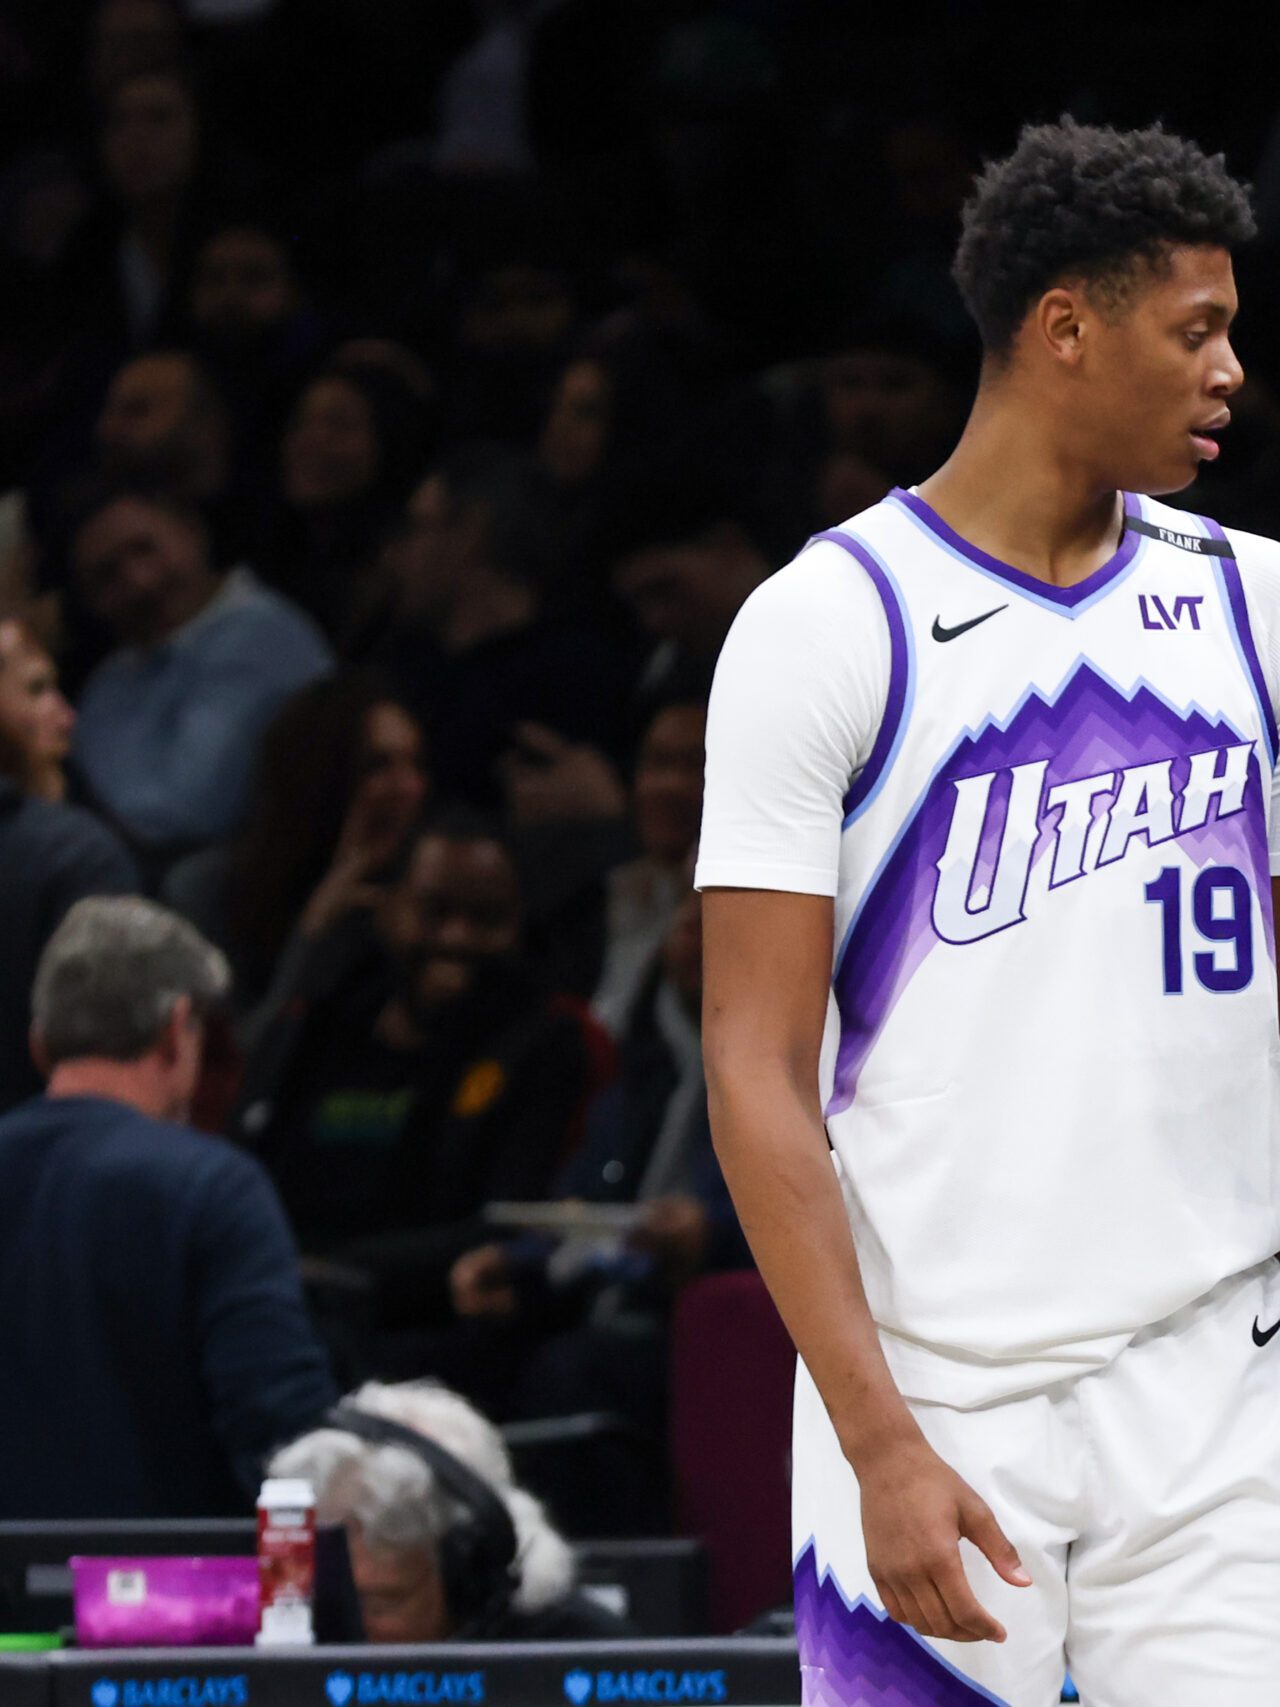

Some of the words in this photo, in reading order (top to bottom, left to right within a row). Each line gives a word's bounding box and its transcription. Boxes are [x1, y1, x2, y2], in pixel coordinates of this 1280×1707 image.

[1158, 527, 1202, 552] FRANK
[1138, 594, 1204, 631] LVT
[930, 739, 1257, 946] UTAH
[1143, 866, 1255, 996] 19
[122, 1674, 248, 1706] BARCLAYS
[357, 1671, 488, 1704] BARCLAYS
[597, 1669, 727, 1700] BARCLAYS
